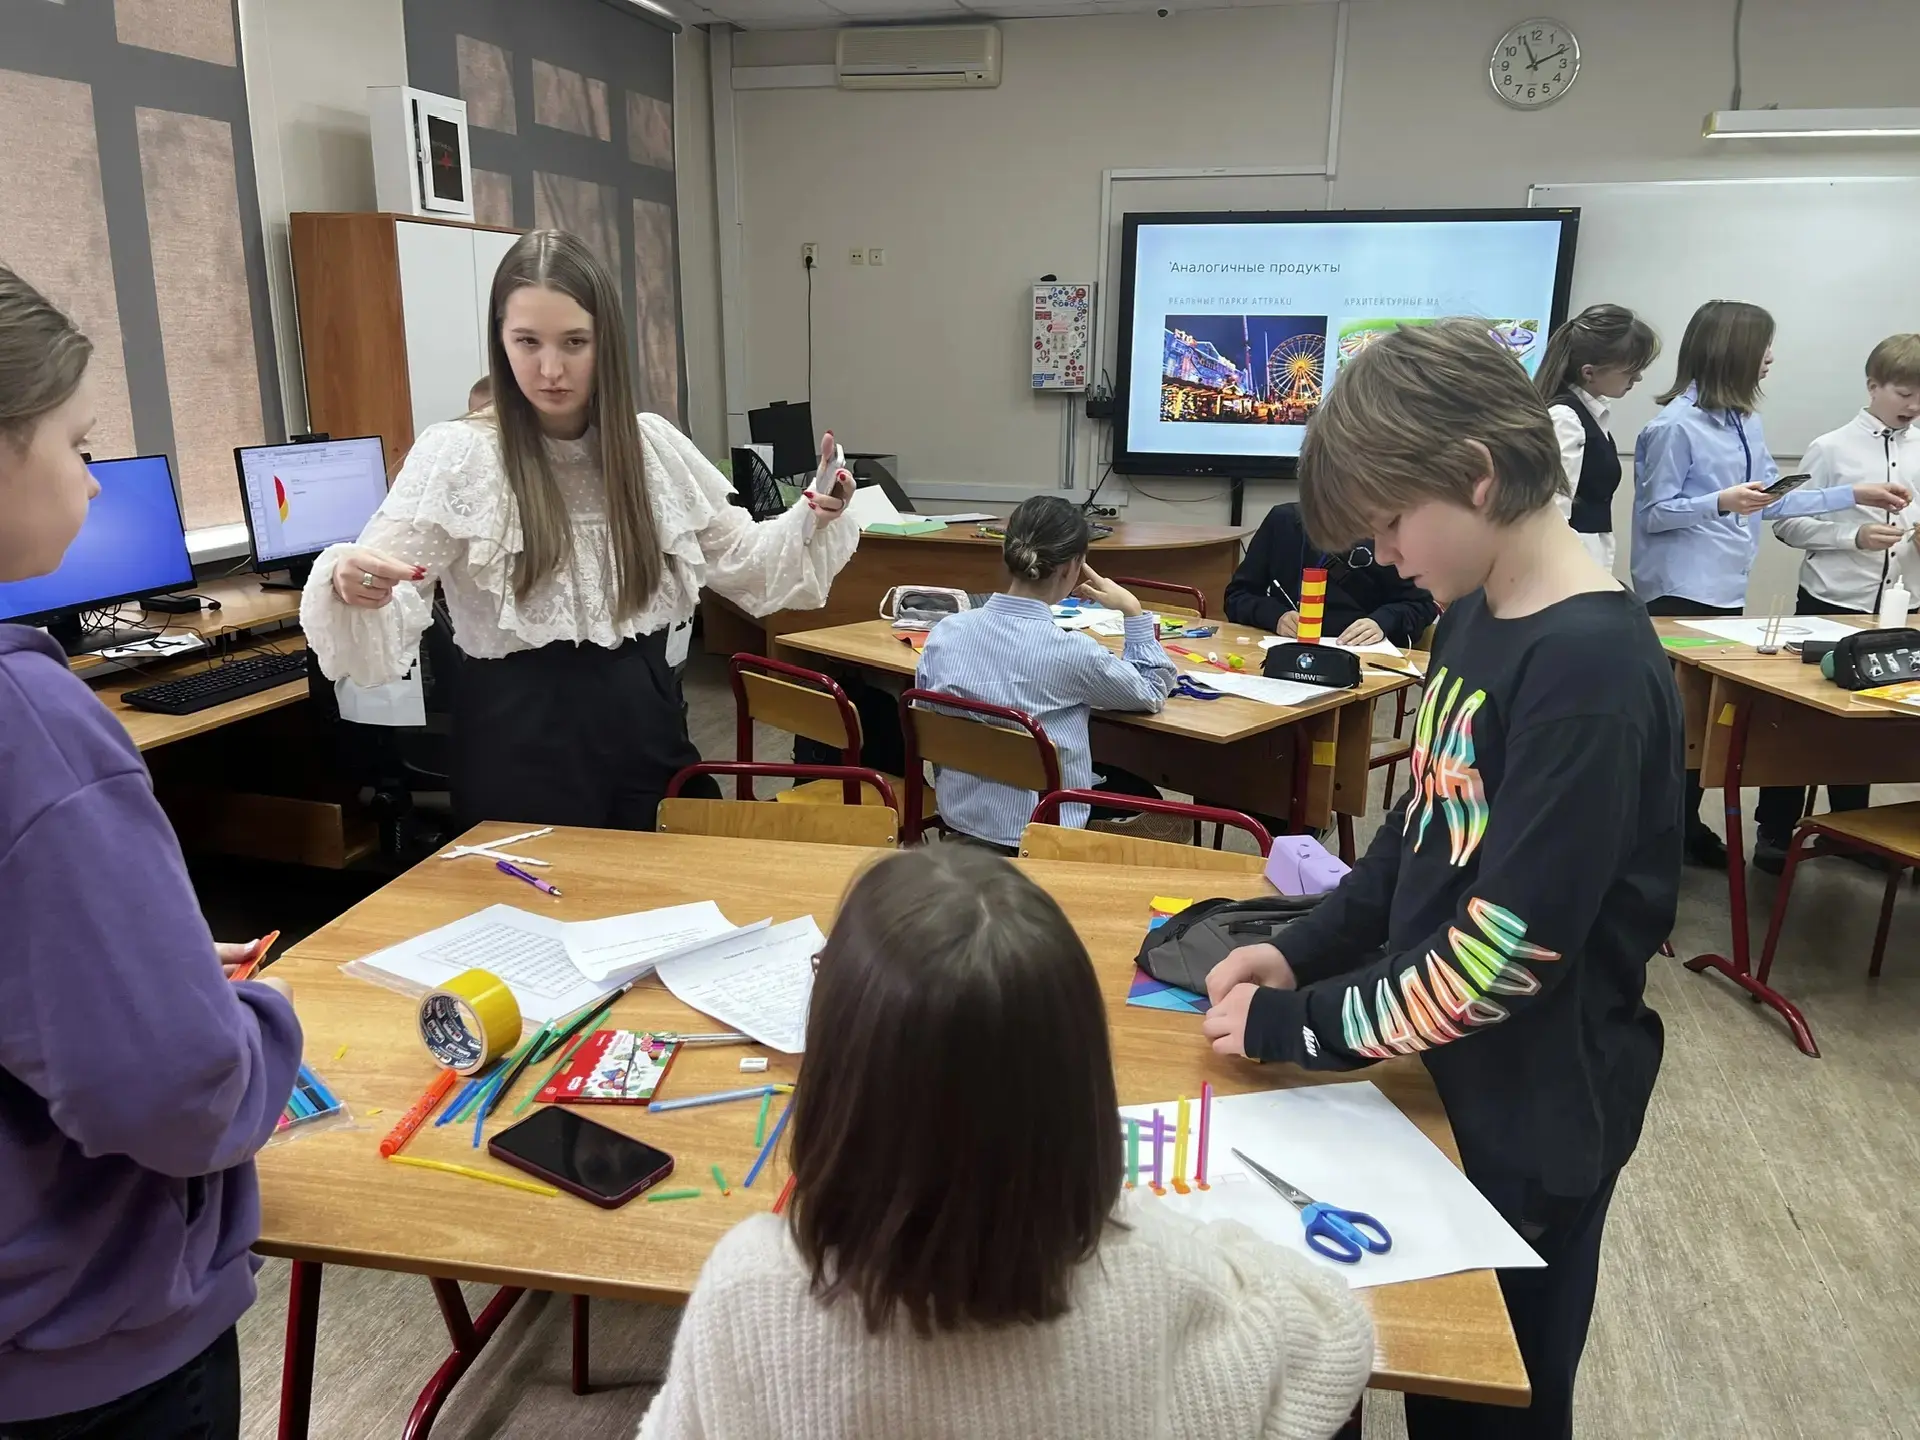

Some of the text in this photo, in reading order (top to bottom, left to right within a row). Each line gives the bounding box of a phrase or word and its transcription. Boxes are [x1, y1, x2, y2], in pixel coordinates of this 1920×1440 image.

[1517, 35, 1527, 45] 11
[1531, 30, 1543, 41] 12
[1505, 46, 1517, 57] 10
[1557, 44, 1566, 54] 2
[1501, 60, 1510, 71] 9
[1559, 58, 1567, 69] 3
[1503, 75, 1512, 85] 8
[1552, 72, 1562, 83] 4
[1515, 84, 1523, 95] 7
[1527, 87, 1535, 98] 6
[1542, 83, 1550, 93] 5
[1170, 262, 1340, 275] Аналогичные продукты
[1219, 297, 1248, 305] ПАРКИ
[1294, 672, 1316, 681] BMW
